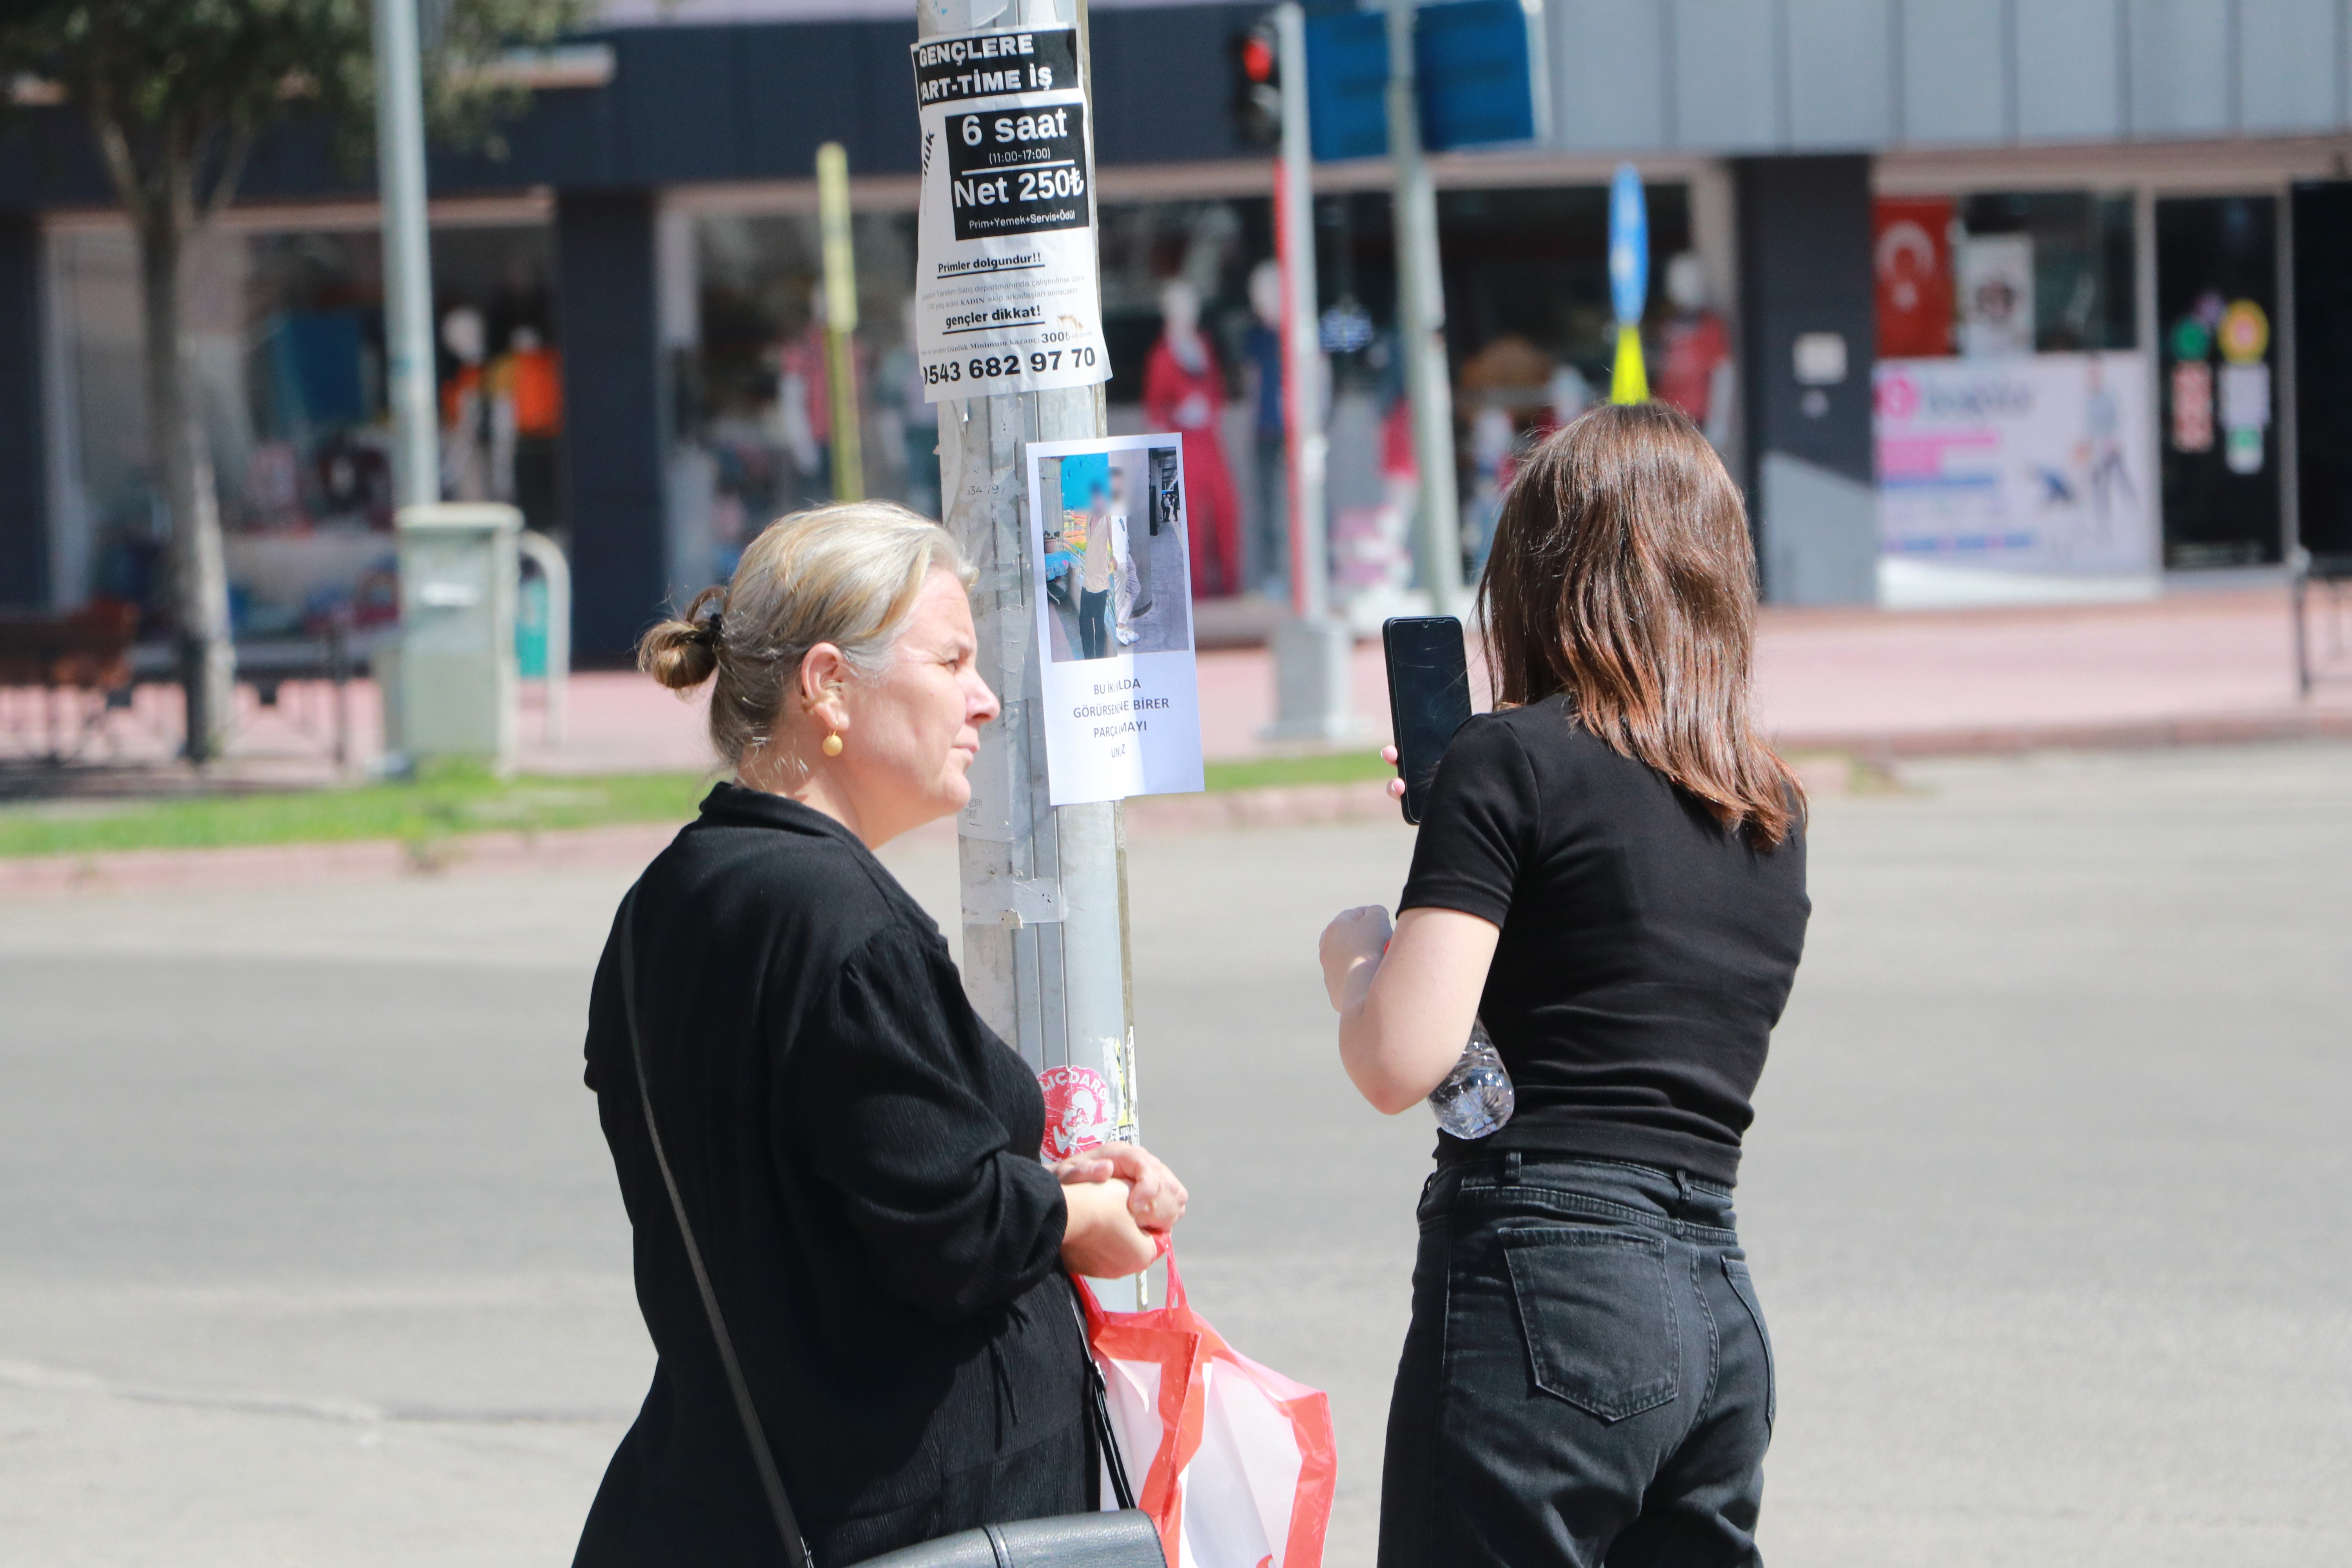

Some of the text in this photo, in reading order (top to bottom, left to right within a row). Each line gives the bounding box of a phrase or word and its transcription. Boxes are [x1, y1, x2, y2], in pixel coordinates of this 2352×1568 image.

[919, 34, 1034, 67] GENÇLERE
[920, 62, 1053, 102] ART-TİME İŞ
[962, 108, 1067, 146] 6 saat
[989, 147, 1051, 165] (11:00-17:00)
[954, 177, 1009, 208] Net
[938, 252, 1041, 273] Primler dolgundur!!
[960, 297, 985, 305] KADIN
[988, 294, 1004, 303] ekip
[946, 305, 1041, 328] gençler dikkat!
[947, 344, 969, 352] Günlük
[970, 340, 1007, 350] Minimum
[969, 354, 1020, 379] 682
[1030, 350, 1062, 372] 97
[1071, 347, 1096, 368] 70
[1094, 684, 1106, 695] BU
[1134, 697, 1170, 710] BİRER
[1094, 726, 1118, 739] PARÇA
